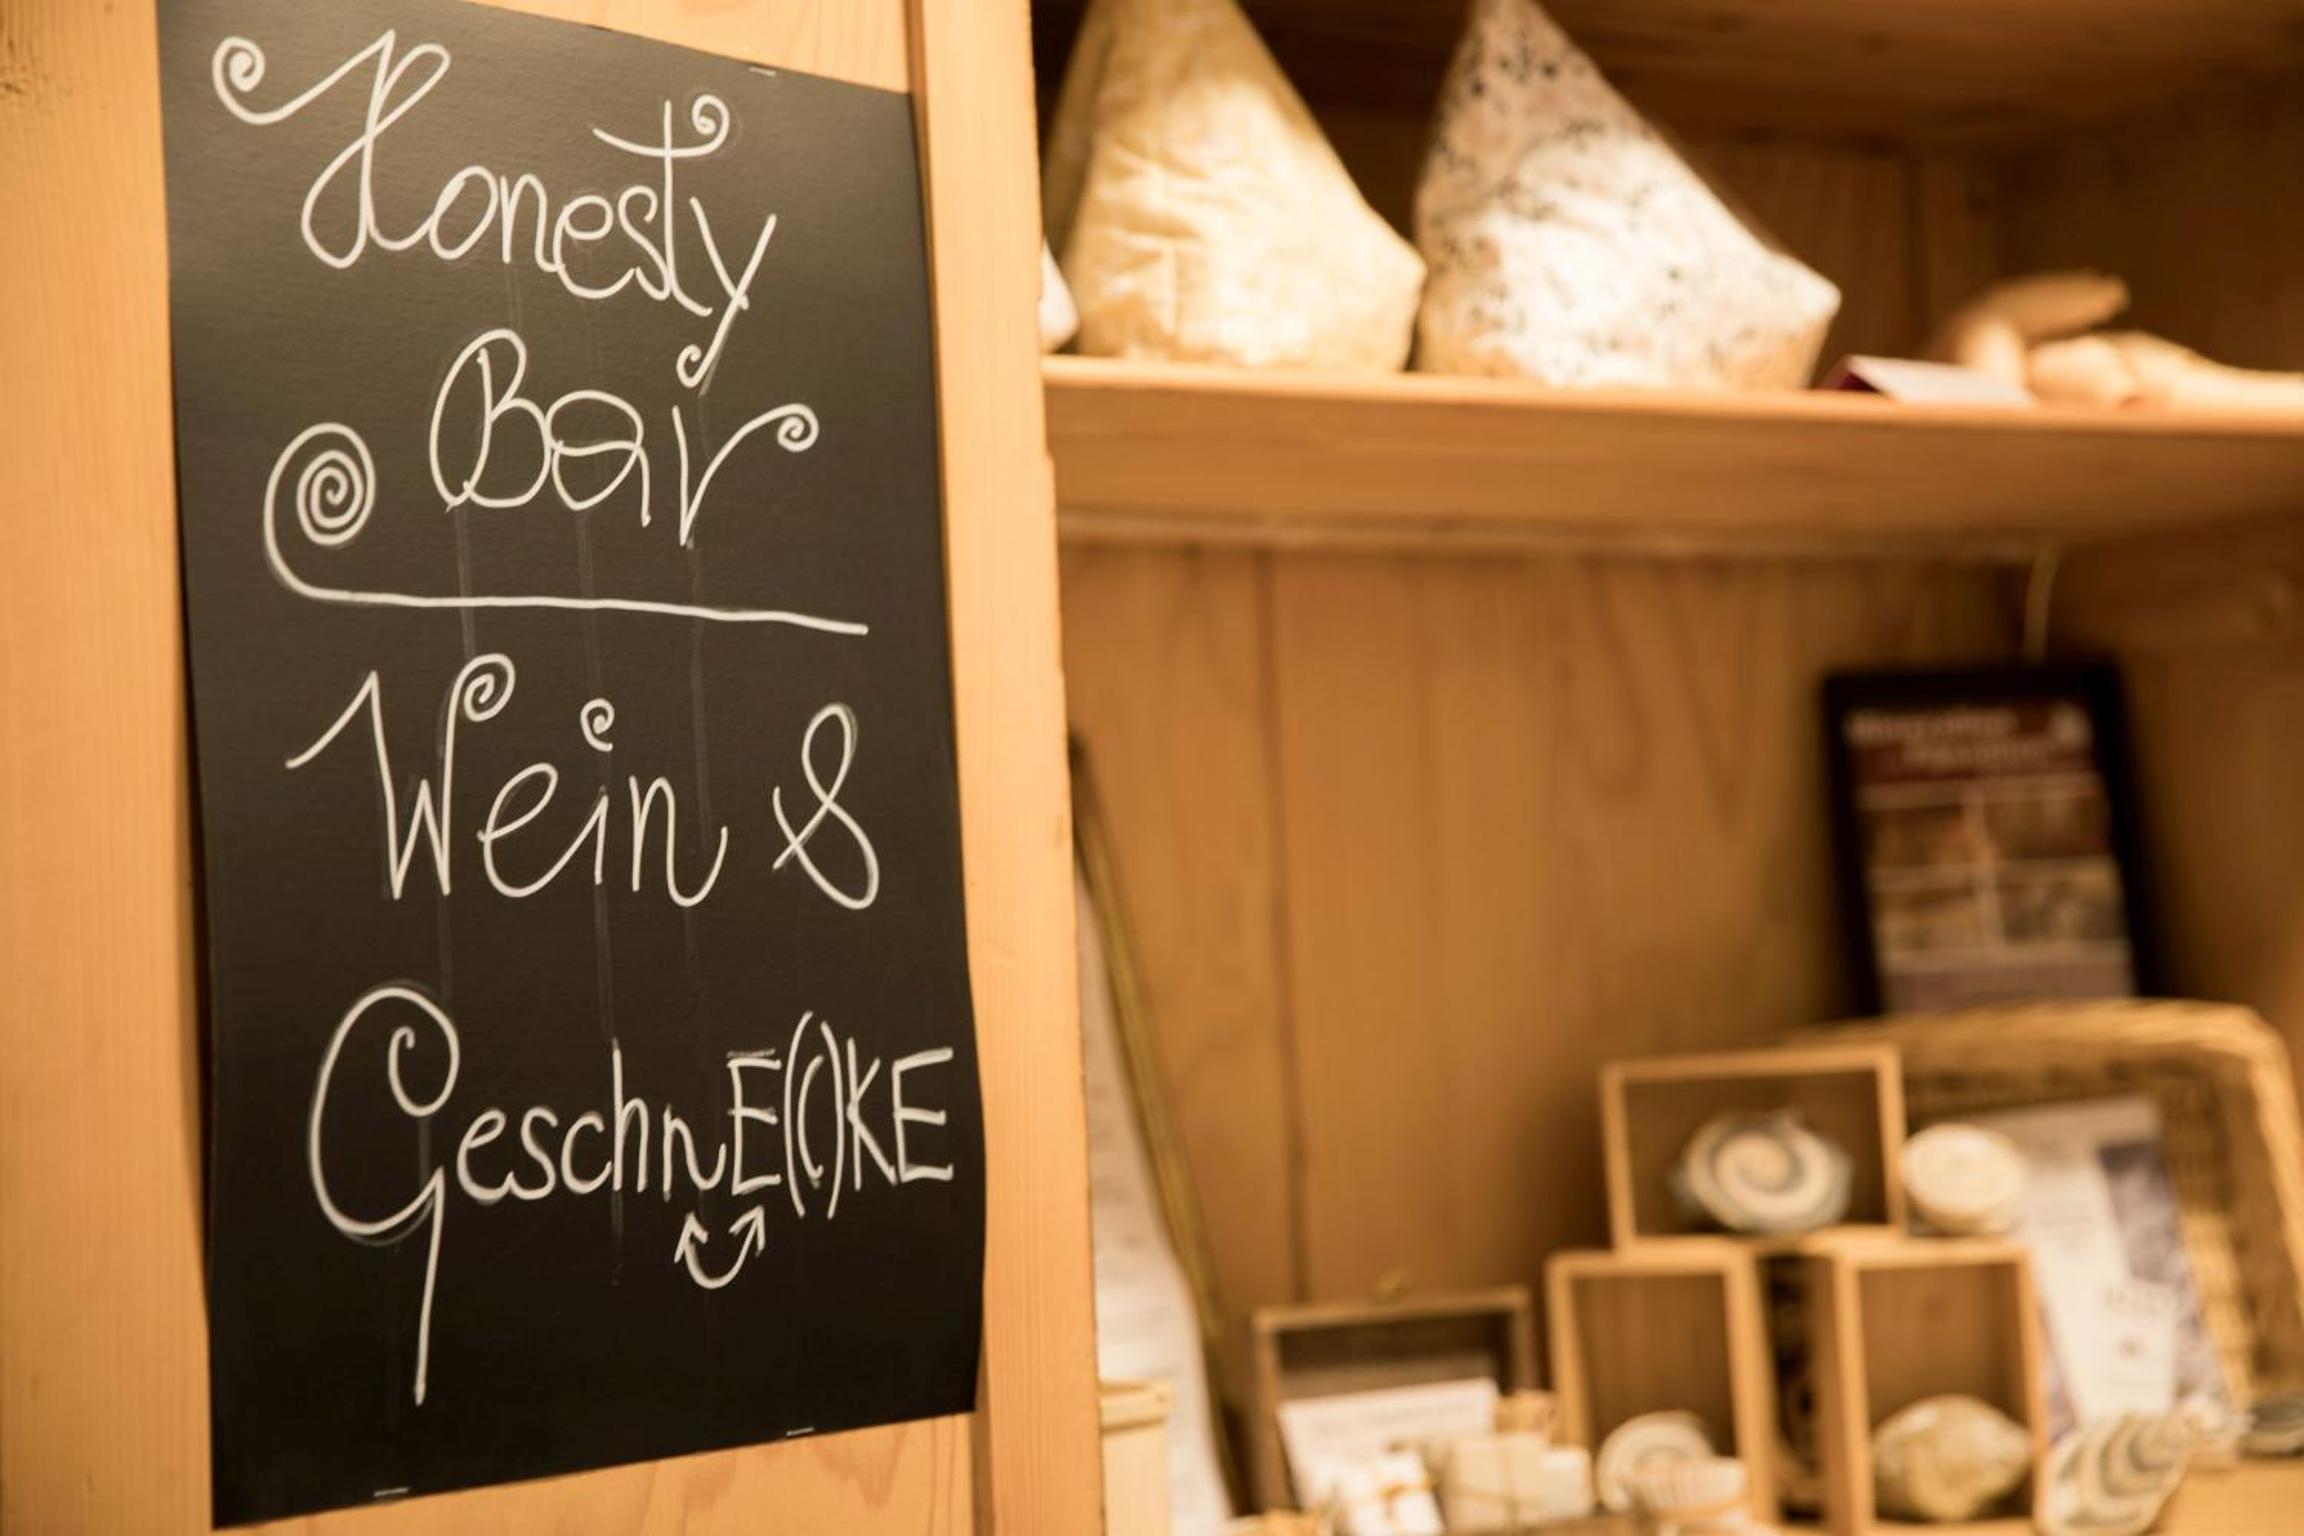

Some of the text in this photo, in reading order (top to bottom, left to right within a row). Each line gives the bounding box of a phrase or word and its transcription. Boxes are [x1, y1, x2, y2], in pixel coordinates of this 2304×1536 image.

[212, 28, 778, 389] Honesty
[427, 326, 820, 548] Bar
[285, 652, 880, 911] Wein &
